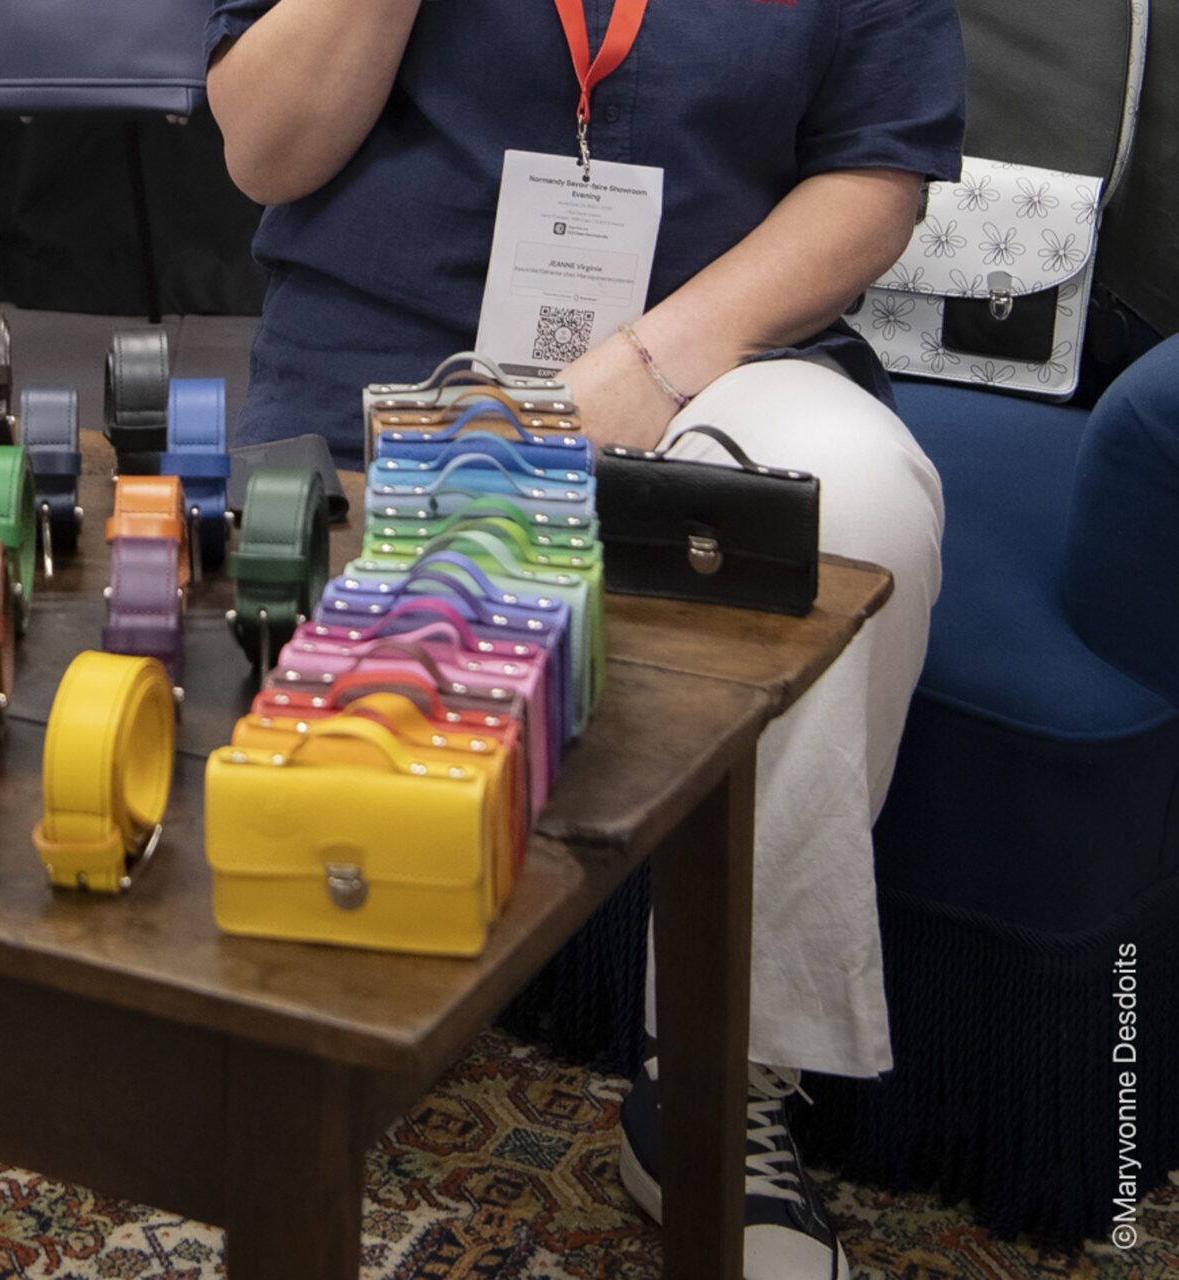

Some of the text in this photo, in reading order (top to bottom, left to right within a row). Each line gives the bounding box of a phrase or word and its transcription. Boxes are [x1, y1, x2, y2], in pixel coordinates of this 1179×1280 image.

[529, 175, 565, 187] Normandy
[609, 185, 648, 196] Showroom
[571, 190, 601, 202] Evening
